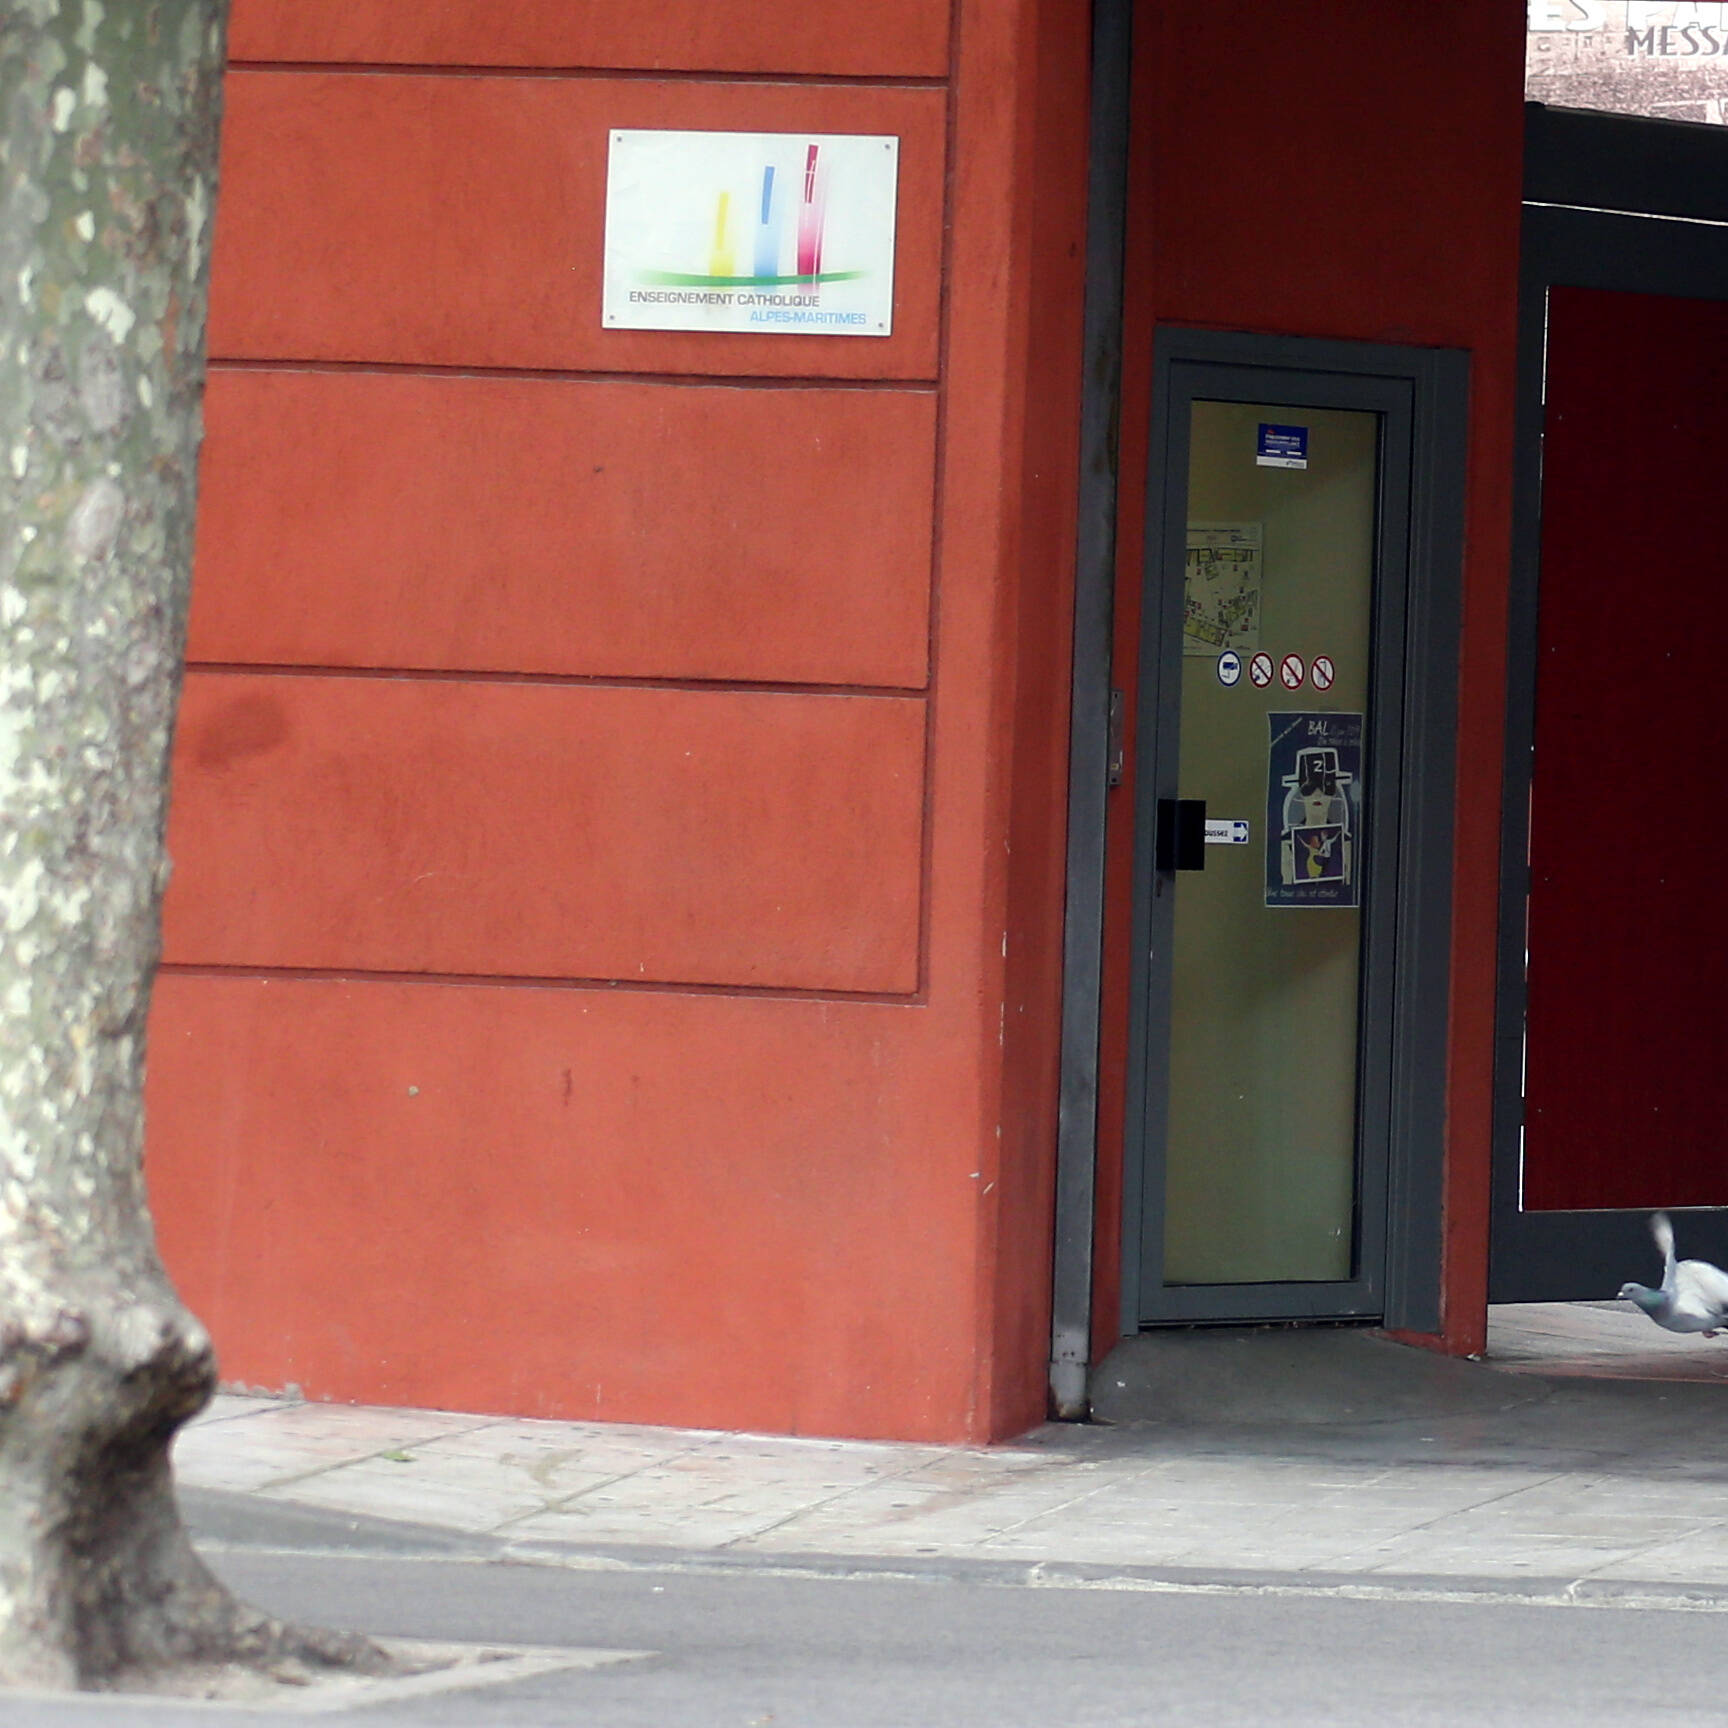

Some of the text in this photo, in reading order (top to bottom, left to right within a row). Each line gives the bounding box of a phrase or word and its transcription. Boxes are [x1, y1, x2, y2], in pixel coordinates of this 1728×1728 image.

[629, 290, 820, 308] ENSEIGNEMENT CATHOLIQUE
[750, 310, 868, 325] ALPES-MARITIMES
[1308, 719, 1329, 736] BAL
